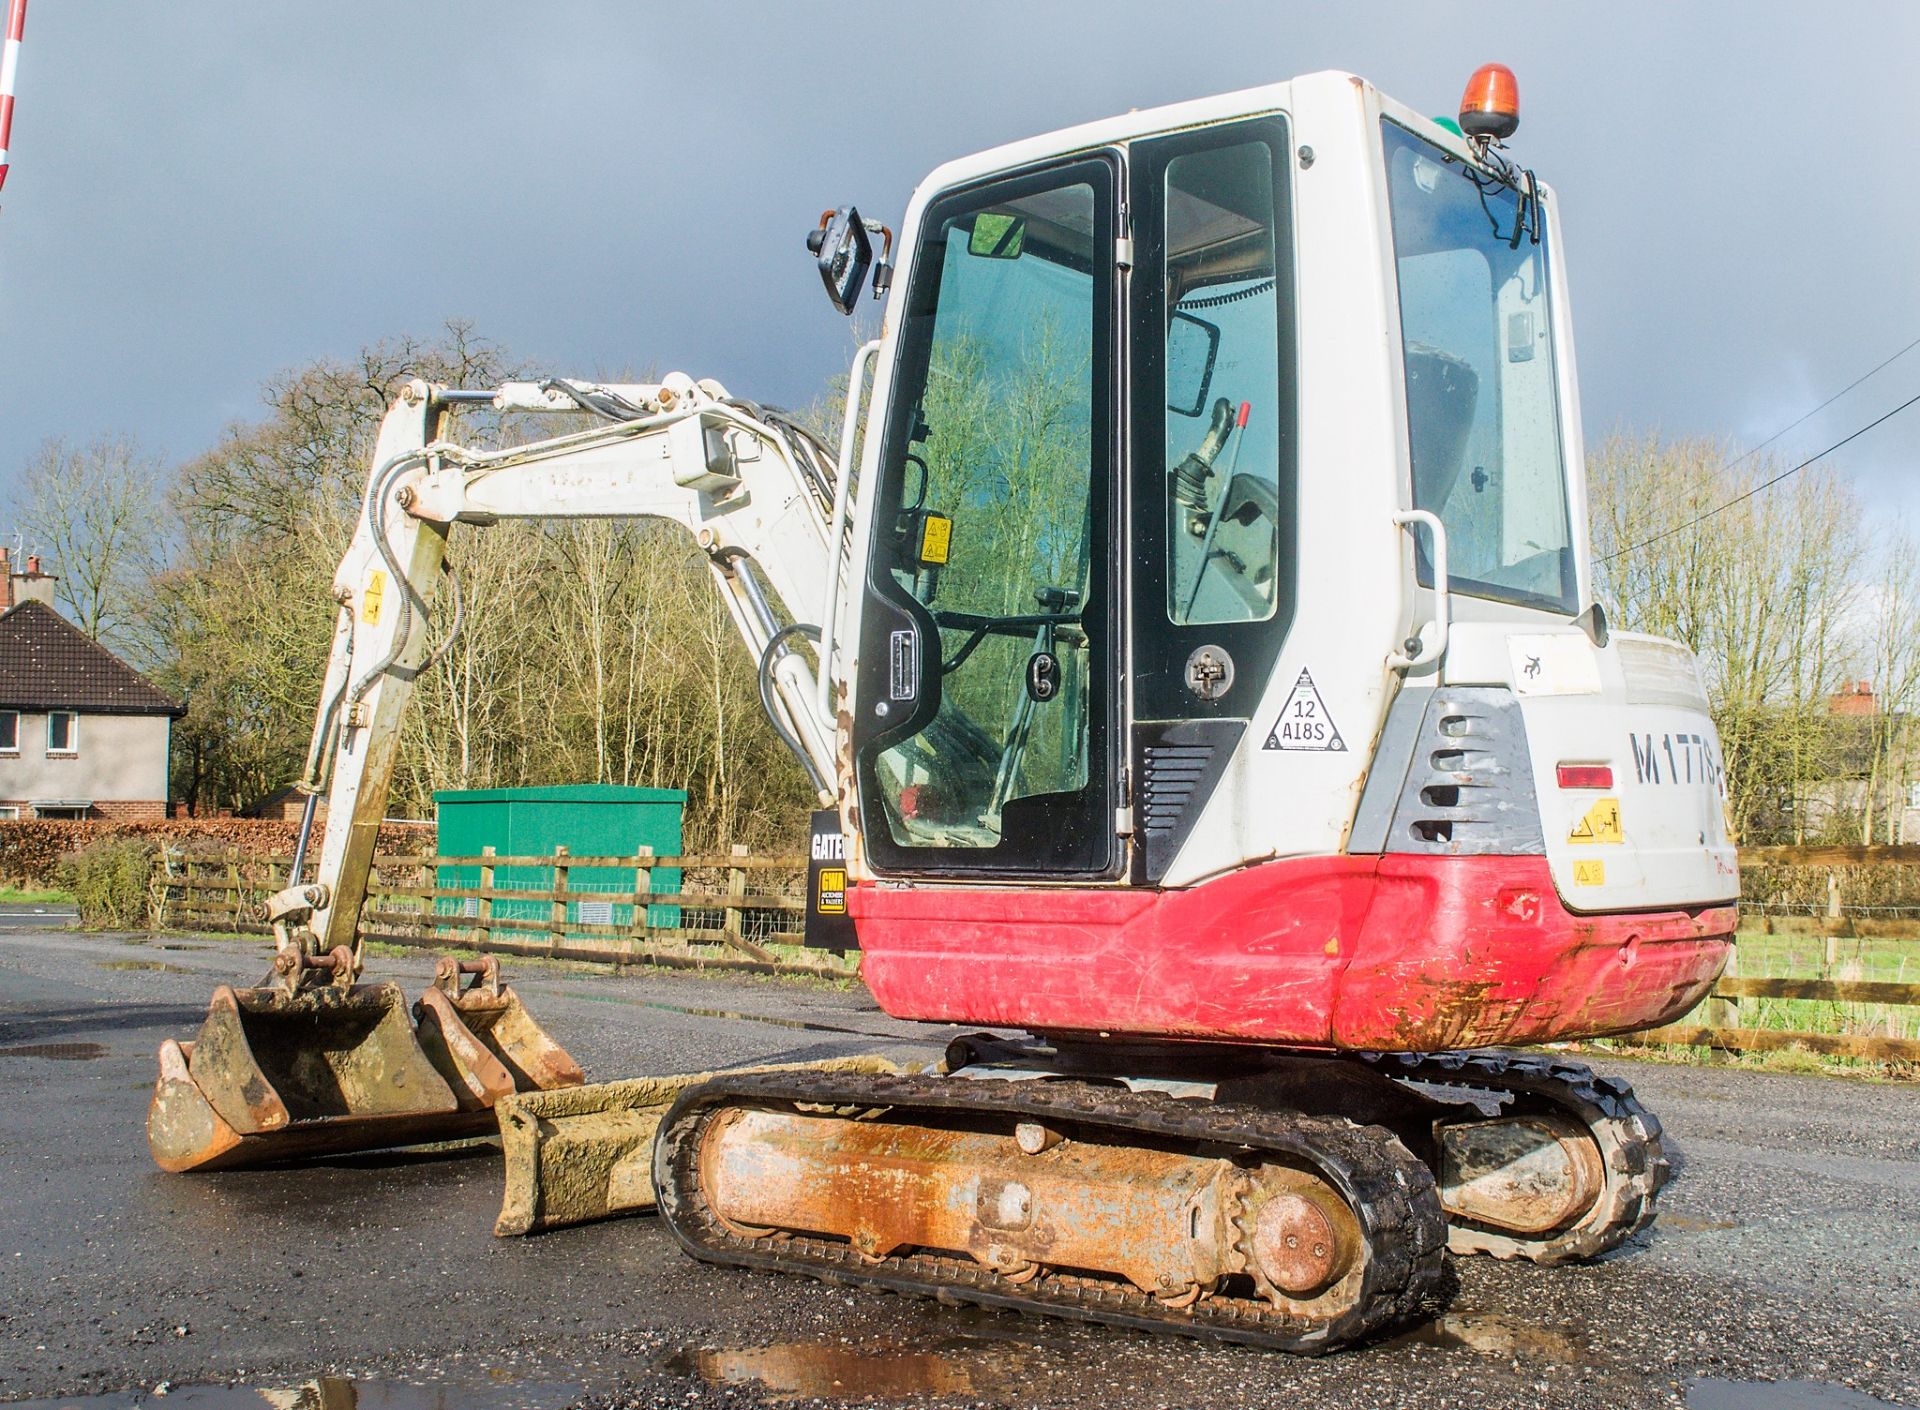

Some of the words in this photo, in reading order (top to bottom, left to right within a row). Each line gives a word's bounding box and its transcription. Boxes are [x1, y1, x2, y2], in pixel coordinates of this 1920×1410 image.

[1294, 700, 1315, 718] 12
[812, 834, 846, 860] GATE
[821, 872, 844, 891] GWA
